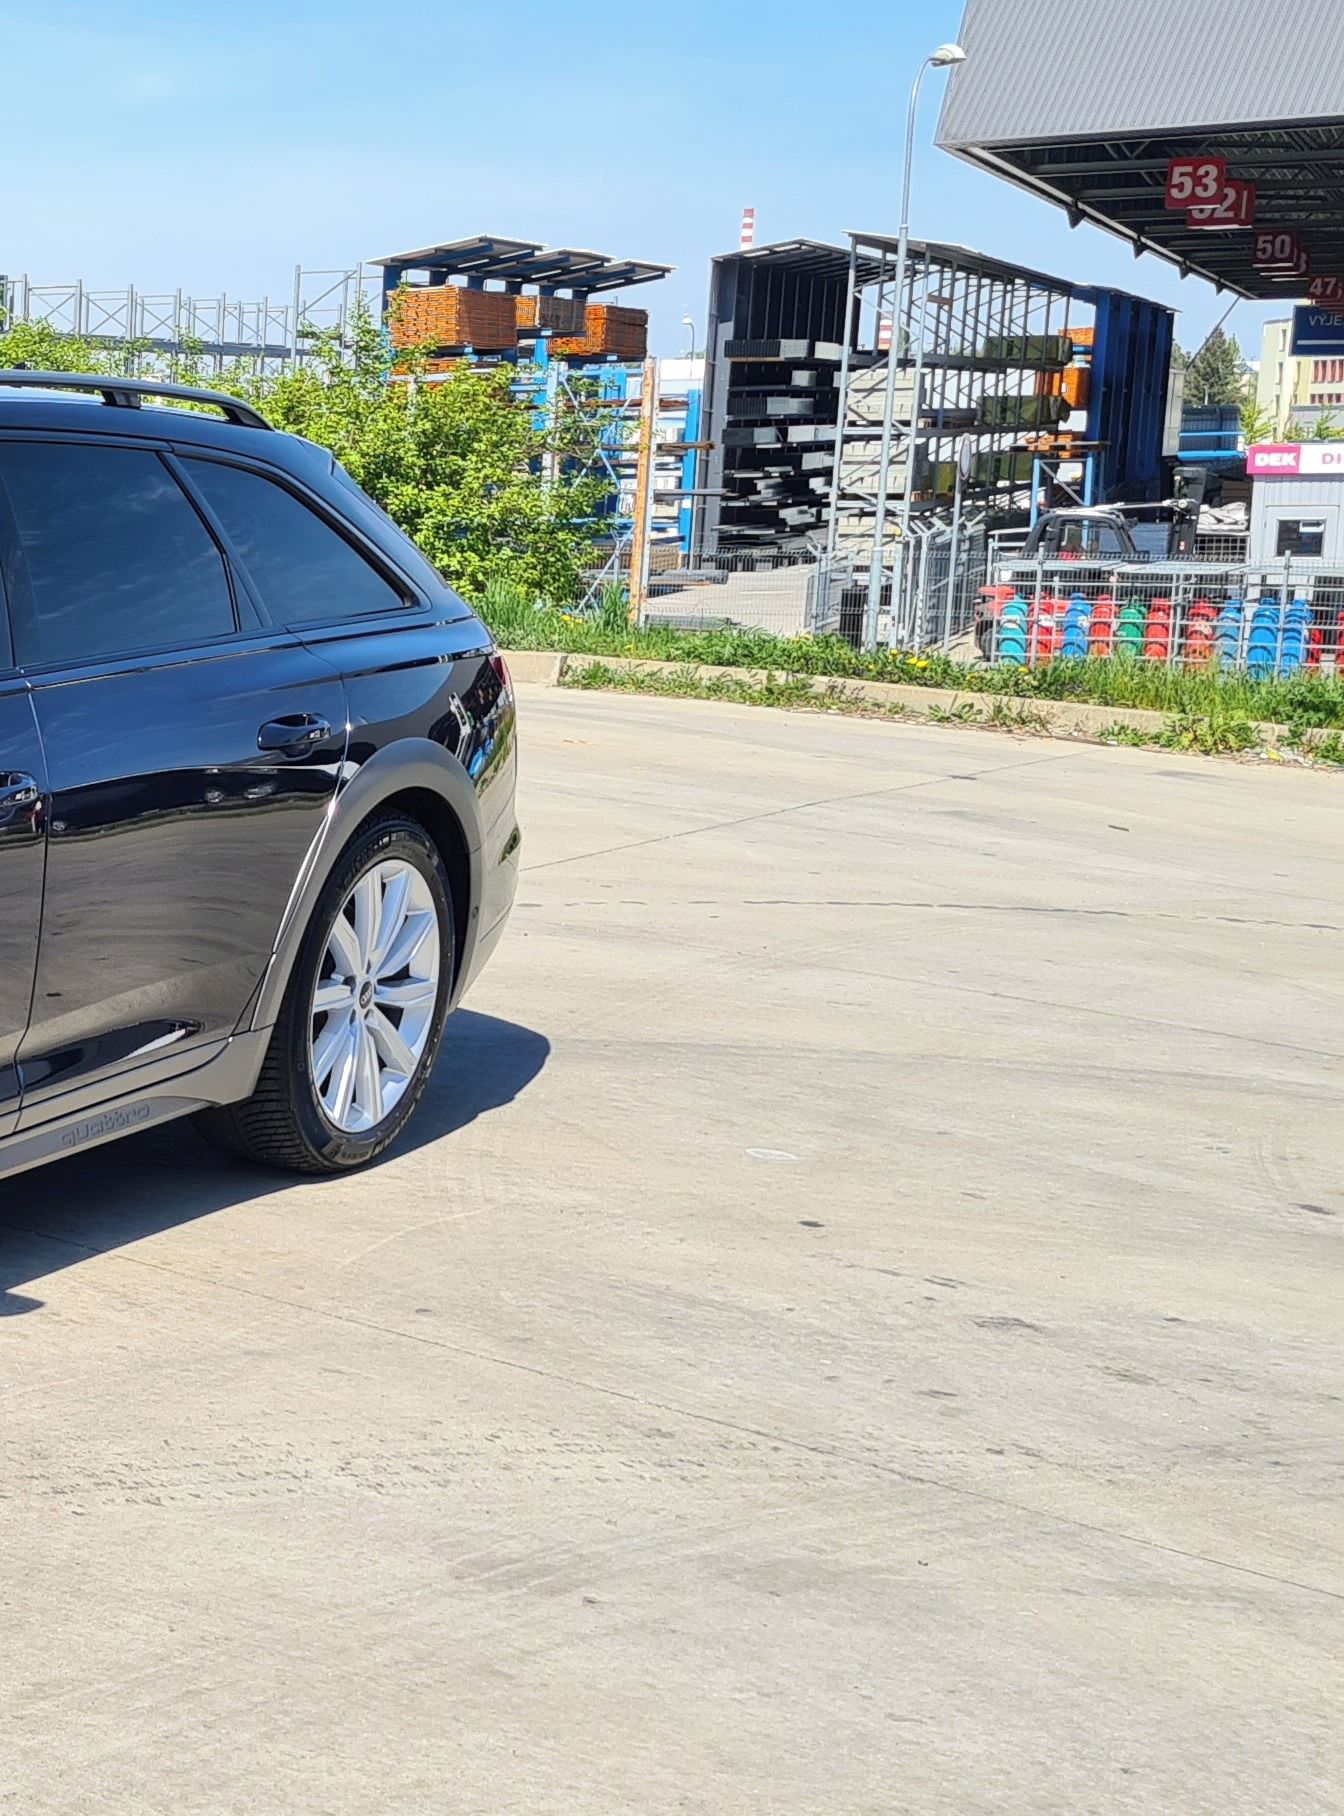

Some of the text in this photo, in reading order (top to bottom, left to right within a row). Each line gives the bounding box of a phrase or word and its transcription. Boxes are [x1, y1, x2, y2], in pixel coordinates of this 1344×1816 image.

[1169, 164, 1219, 200] 53
[1255, 234, 1293, 260] 50
[1309, 277, 1337, 296] 47
[1254, 451, 1298, 468] DEK
